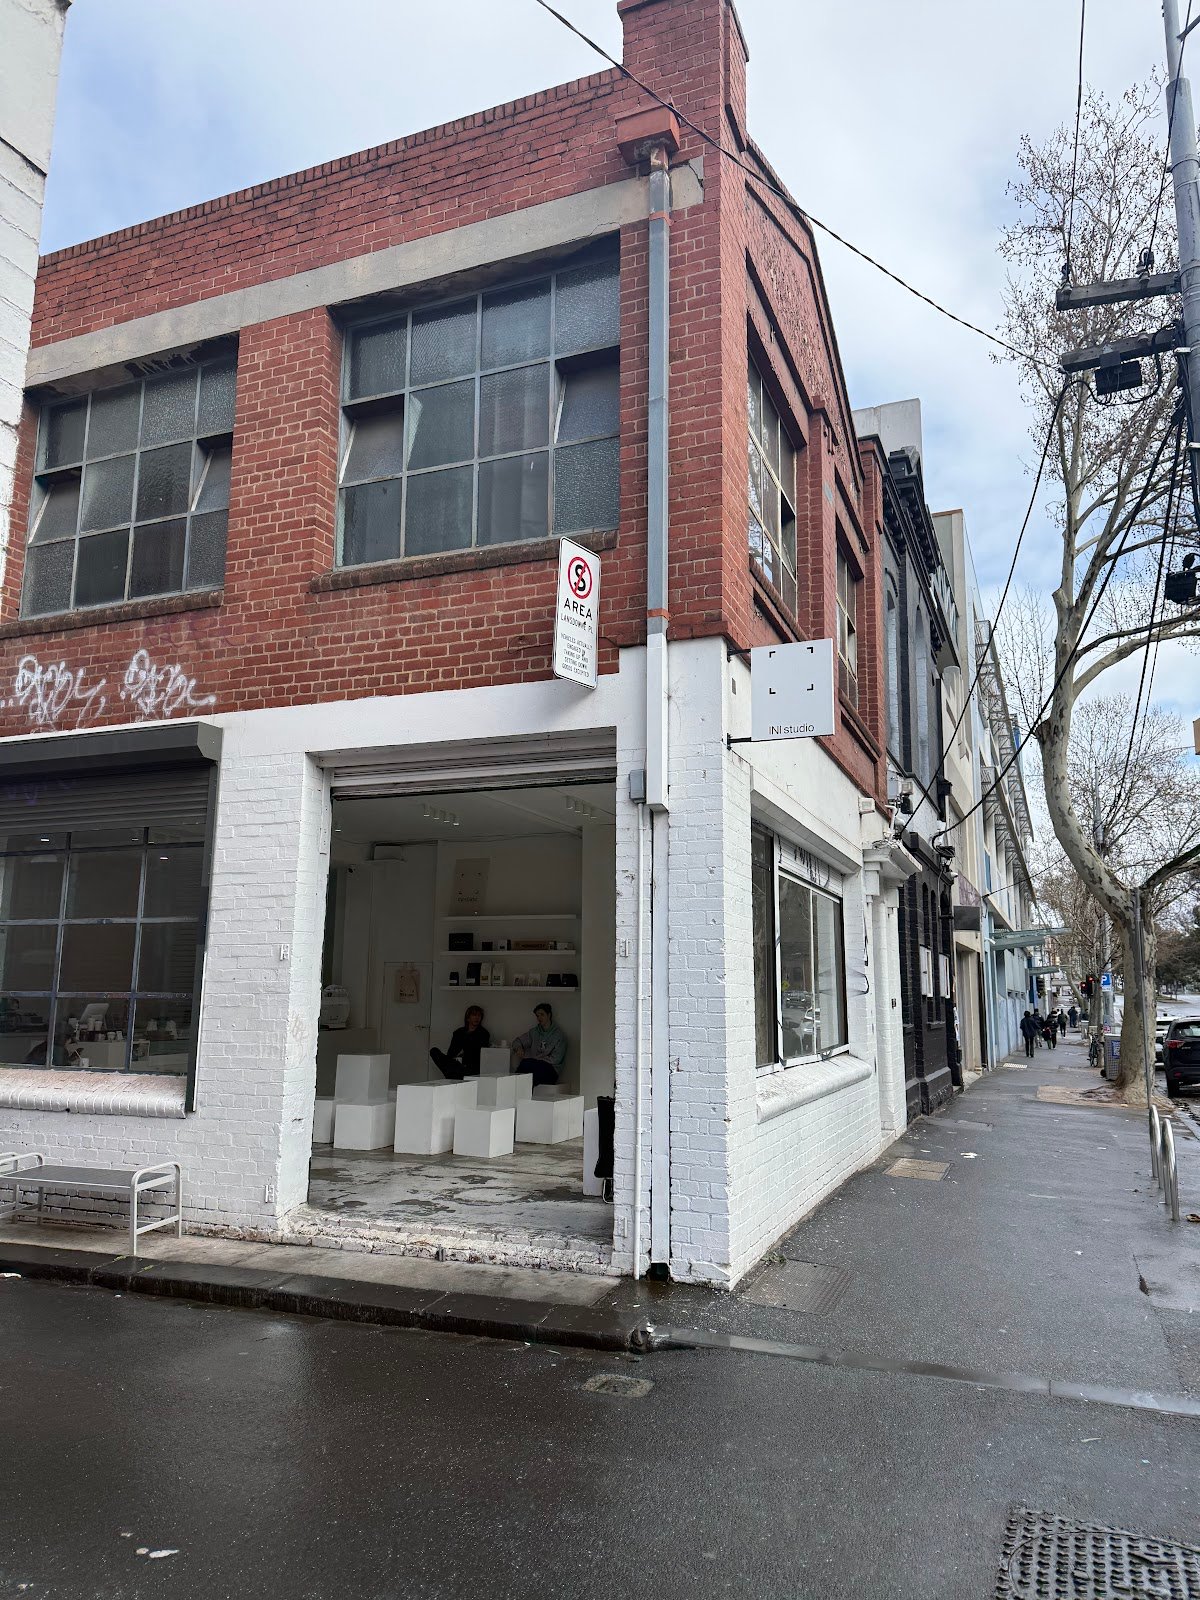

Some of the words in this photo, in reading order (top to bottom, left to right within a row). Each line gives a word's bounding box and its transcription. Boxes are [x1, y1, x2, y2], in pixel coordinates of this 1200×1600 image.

[564, 598, 592, 620] AREA
[588, 625, 593, 634] PL
[784, 722, 814, 734] studio
